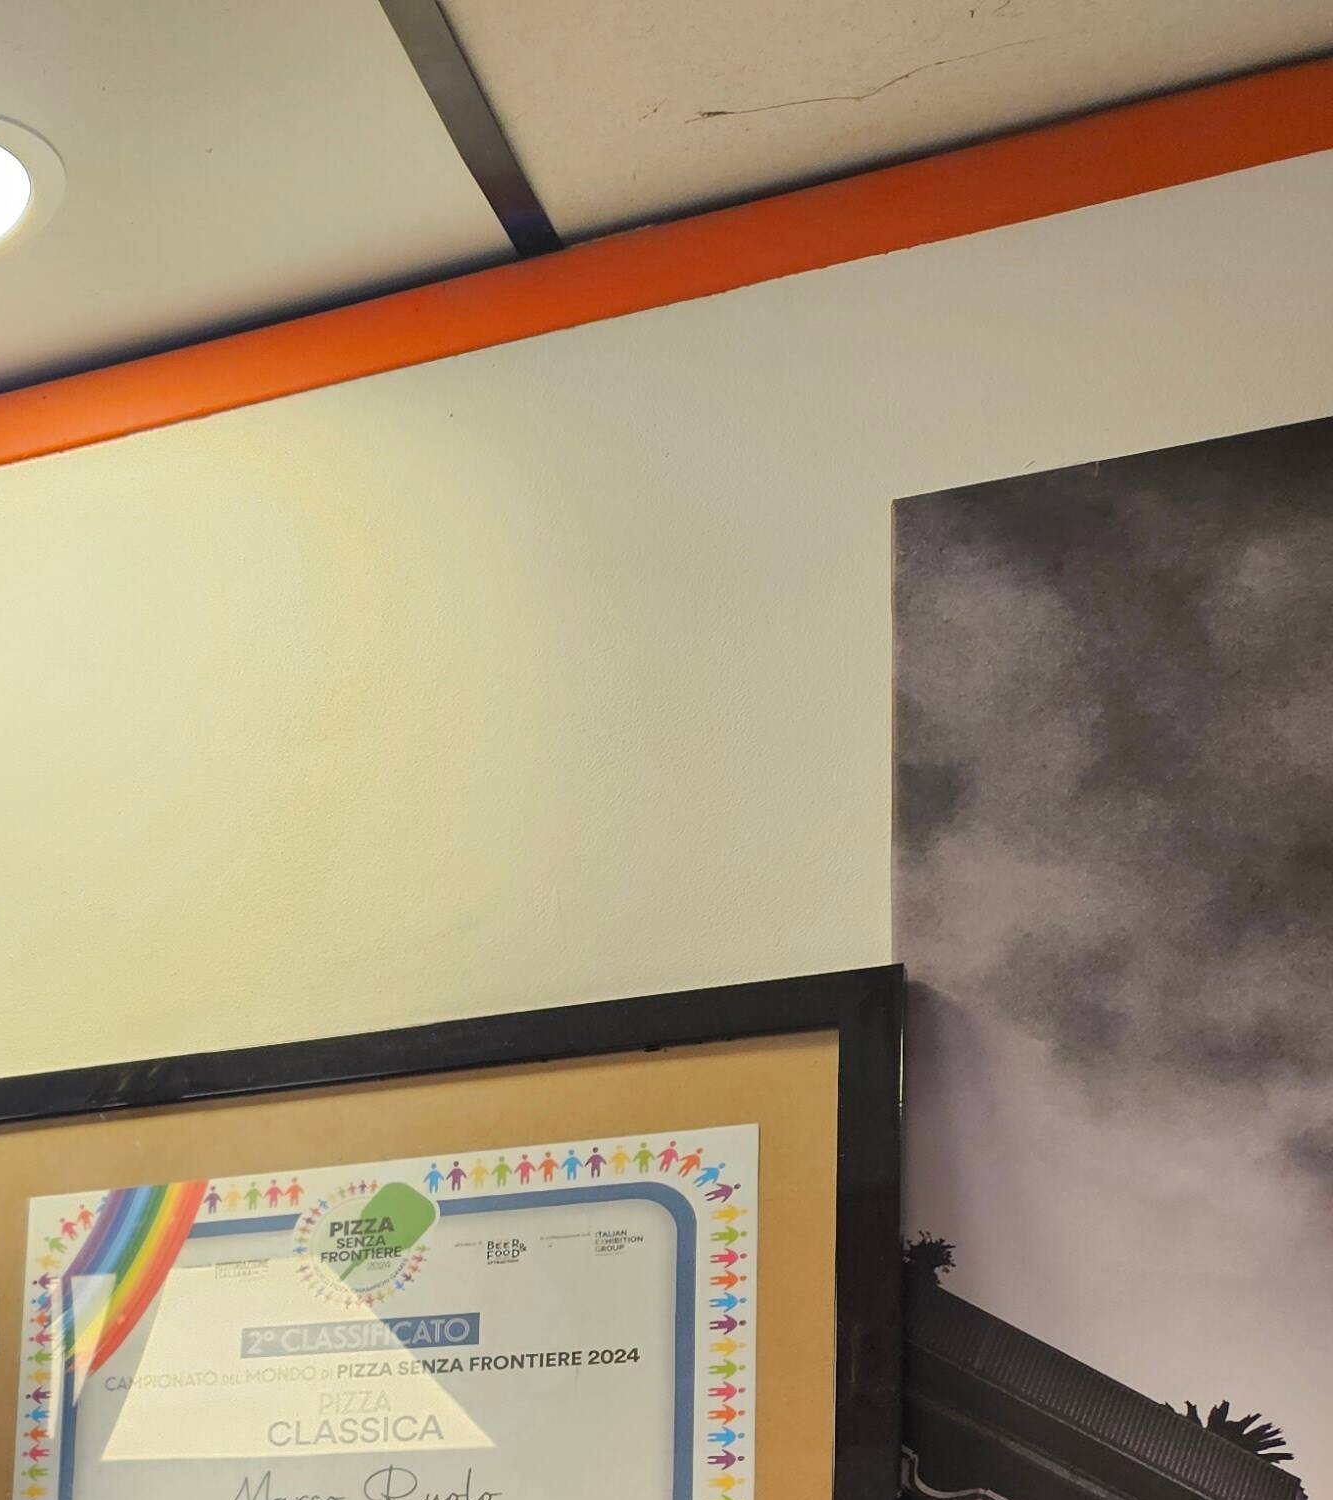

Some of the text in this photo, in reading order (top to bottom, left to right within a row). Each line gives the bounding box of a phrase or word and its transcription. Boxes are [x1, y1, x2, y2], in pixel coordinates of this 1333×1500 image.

[329, 1216, 395, 1238] PIZZA
[320, 1246, 402, 1264] FRONTIERE
[336, 1235, 386, 1250] SENZA
[281, 1317, 471, 1353] CLASSIFICATO
[105, 1370, 218, 1391] CAMPIONATO
[245, 1364, 317, 1383] MONDO
[337, 1360, 393, 1378] PIZZA
[397, 1357, 464, 1375] SENZA
[469, 1350, 583, 1373] FRONTIERE
[587, 1347, 641, 1366] 2024
[318, 1390, 393, 1415] PIZZA
[267, 1413, 445, 1447] CLASSICA
